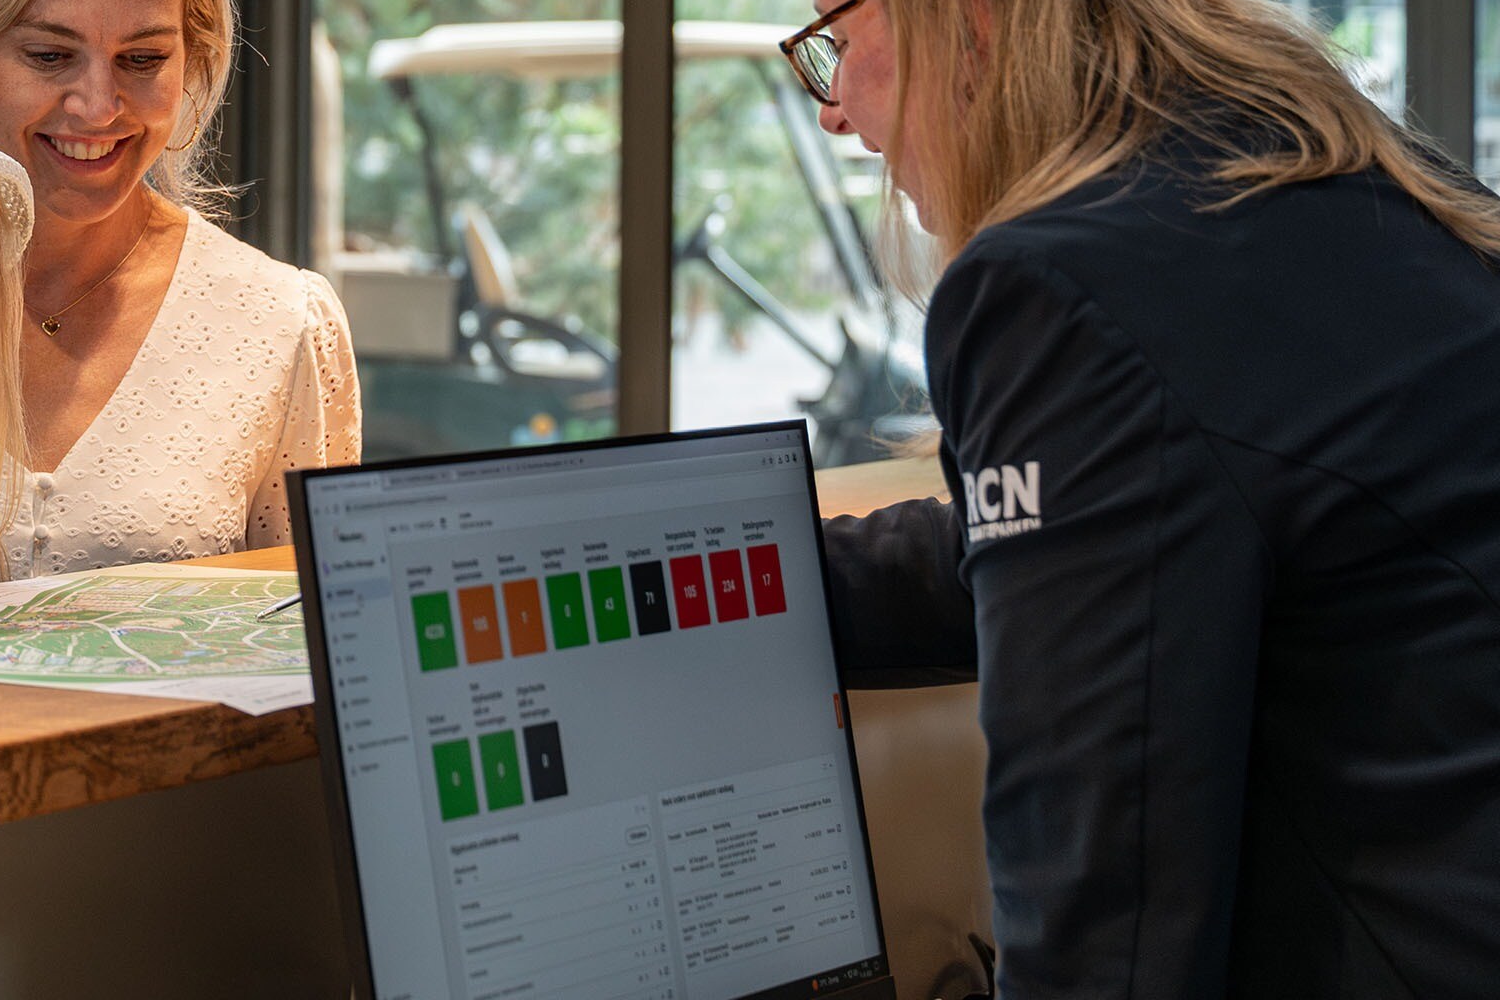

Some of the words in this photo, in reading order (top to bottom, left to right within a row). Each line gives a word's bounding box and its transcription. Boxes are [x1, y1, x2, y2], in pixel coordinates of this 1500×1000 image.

[962, 461, 1041, 525] RCN
[722, 579, 736, 593] 234
[762, 573, 772, 587] 17
[683, 585, 698, 599] 105
